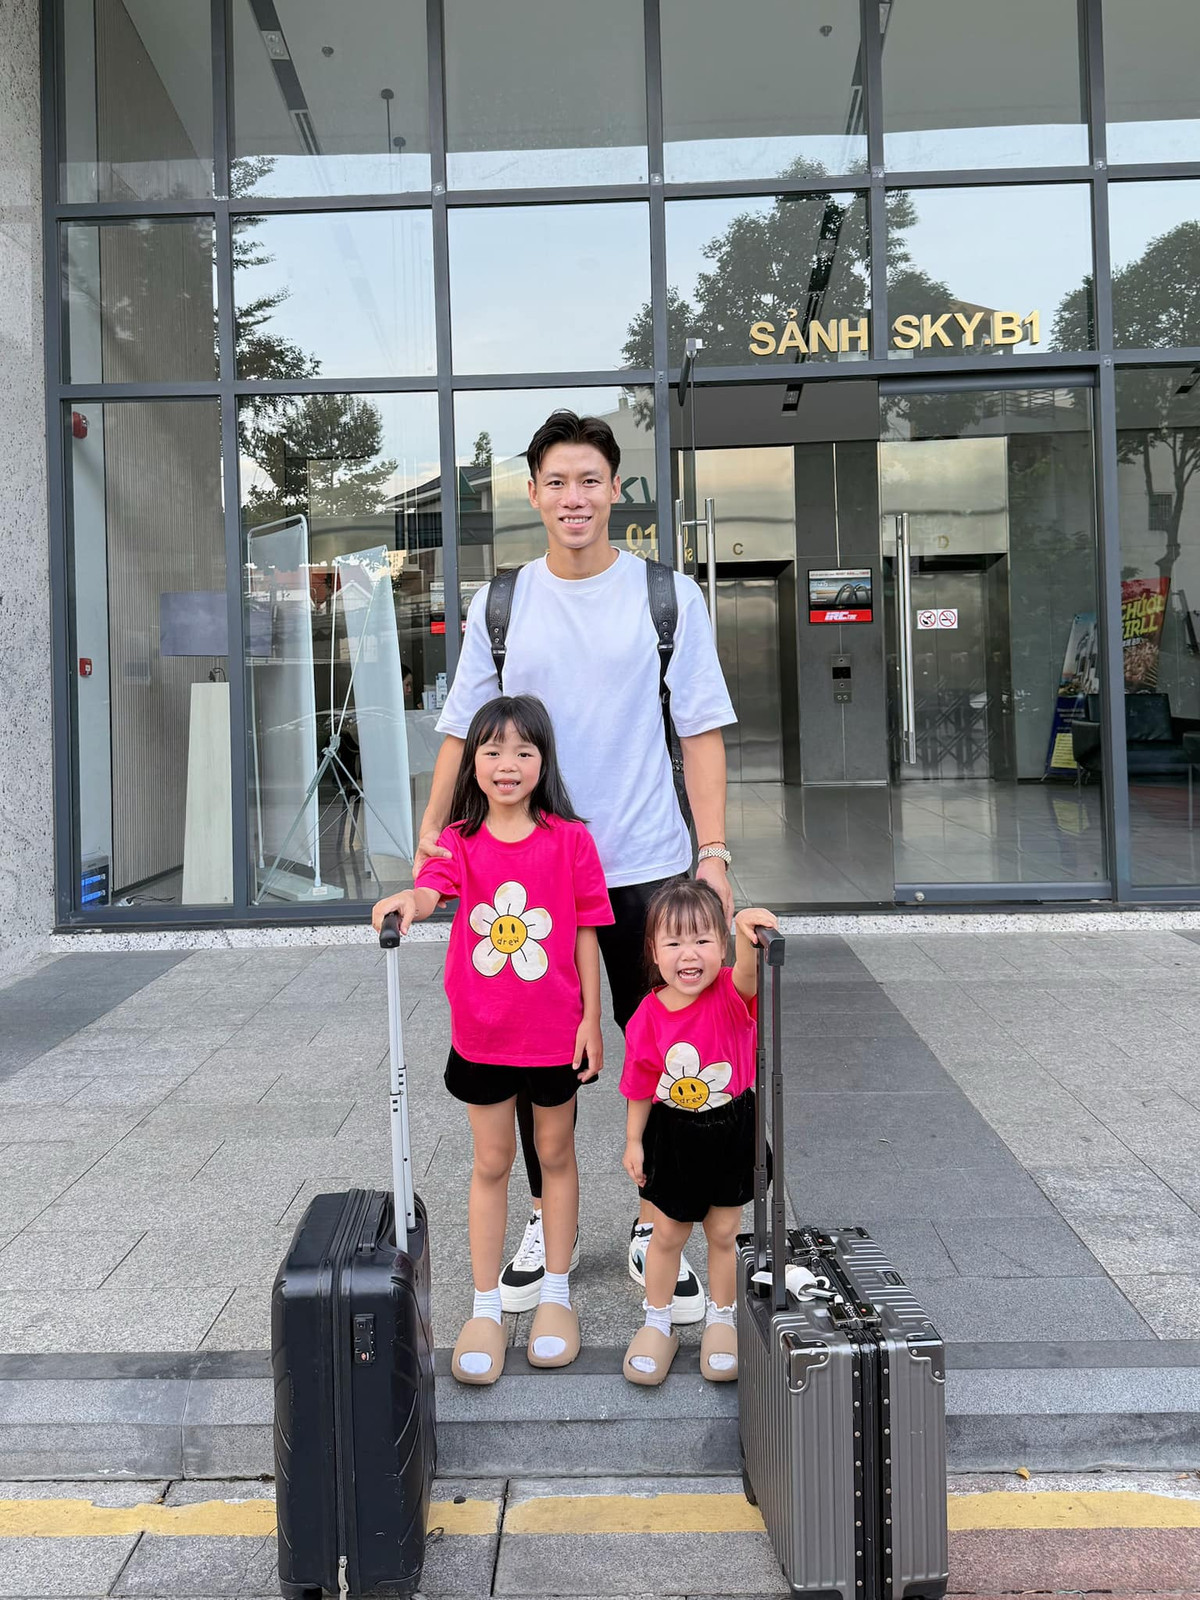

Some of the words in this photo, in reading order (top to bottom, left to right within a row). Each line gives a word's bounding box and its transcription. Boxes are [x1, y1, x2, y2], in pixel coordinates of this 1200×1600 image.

[749, 308, 868, 355] SẢNH
[893, 310, 1040, 349] SKY.B1
[625, 523, 657, 550] 01
[733, 542, 744, 556] C
[496, 936, 520, 946] drew
[679, 1093, 703, 1104] drew
